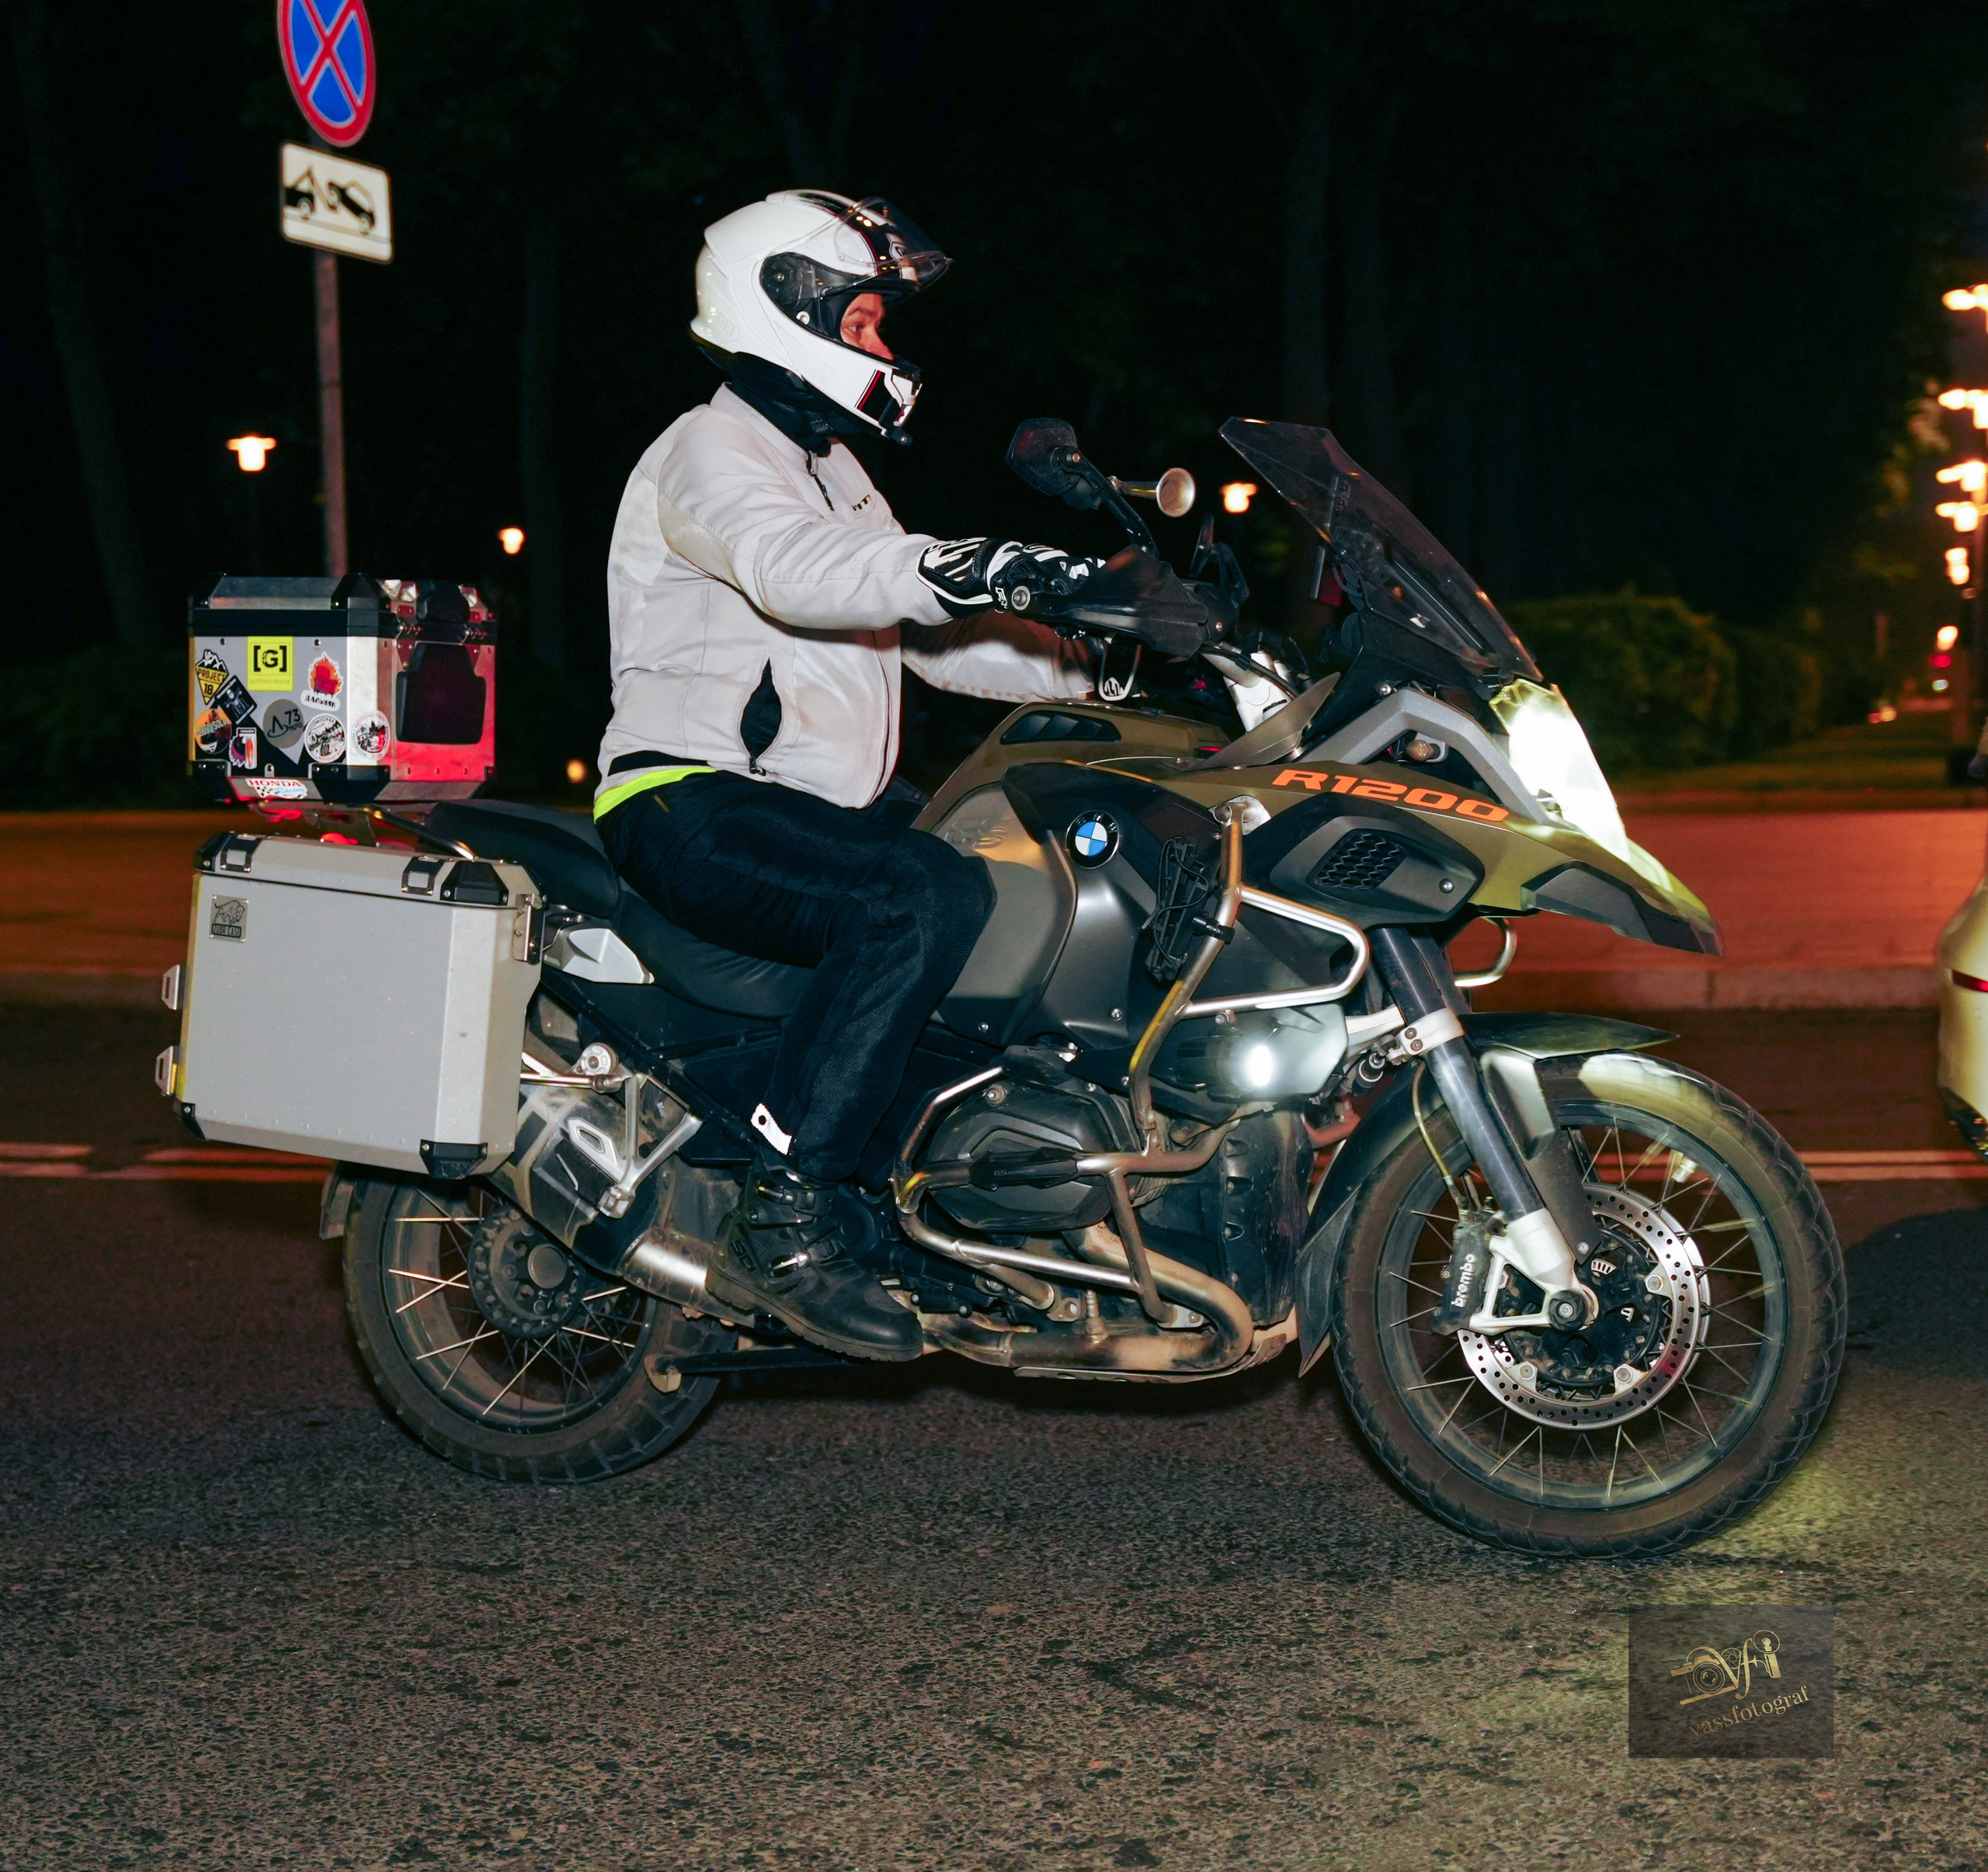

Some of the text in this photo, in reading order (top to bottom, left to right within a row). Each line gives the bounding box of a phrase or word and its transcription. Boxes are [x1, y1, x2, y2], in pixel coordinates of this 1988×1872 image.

[197, 669, 225, 682] PROJECT
[203, 683, 214, 695] 18
[304, 695, 336, 708] ДАЛЬНИК
[284, 708, 301, 725] 73
[1271, 769, 1510, 822] R1200
[1076, 812, 1118, 834] BMW
[1451, 1253, 1475, 1308] brembo
